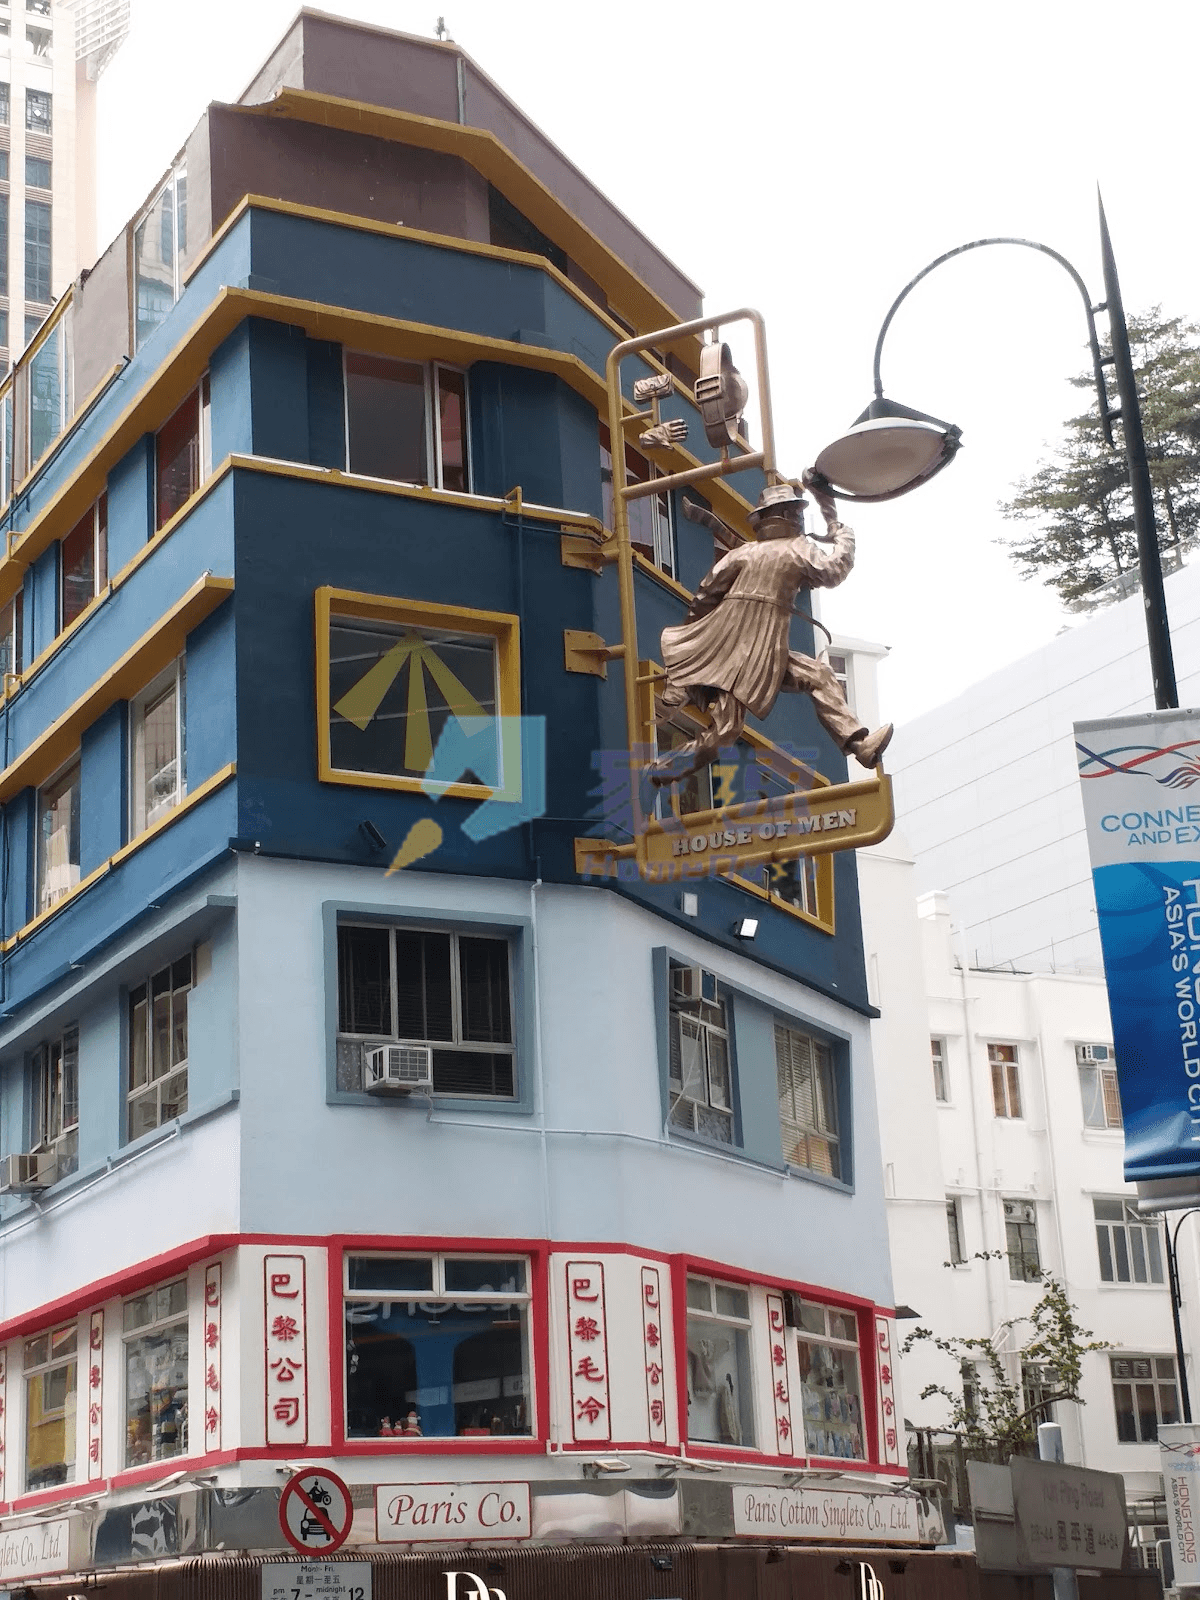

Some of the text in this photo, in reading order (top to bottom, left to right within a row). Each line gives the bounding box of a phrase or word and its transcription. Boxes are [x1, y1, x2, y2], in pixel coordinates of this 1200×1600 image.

[672, 808, 858, 857] HOUSE OF MEN
[1127, 830, 1172, 847] AND
[1162, 886, 1189, 973] ASIA'S
[1175, 976, 1200, 1078] WORLD
[271, 1273, 302, 1427] 巴黎公司
[572, 1278, 606, 1426] 巴黎毛冷
[644, 1284, 664, 1427] 巴黎公司
[386, 1490, 522, 1528] Paris Co.
[744, 1493, 777, 1523] Paris
[779, 1496, 819, 1528] Cotton
[821, 1496, 865, 1537] Singlets
[889, 1500, 911, 1530] Ltd.
[1177, 1476, 1191, 1520] HONG
[41, 1524, 63, 1561] Ltd.
[1183, 1520, 1197, 1564] KONG
[316, 1586, 346, 1594] midnight
[348, 1587, 365, 1600] 12
